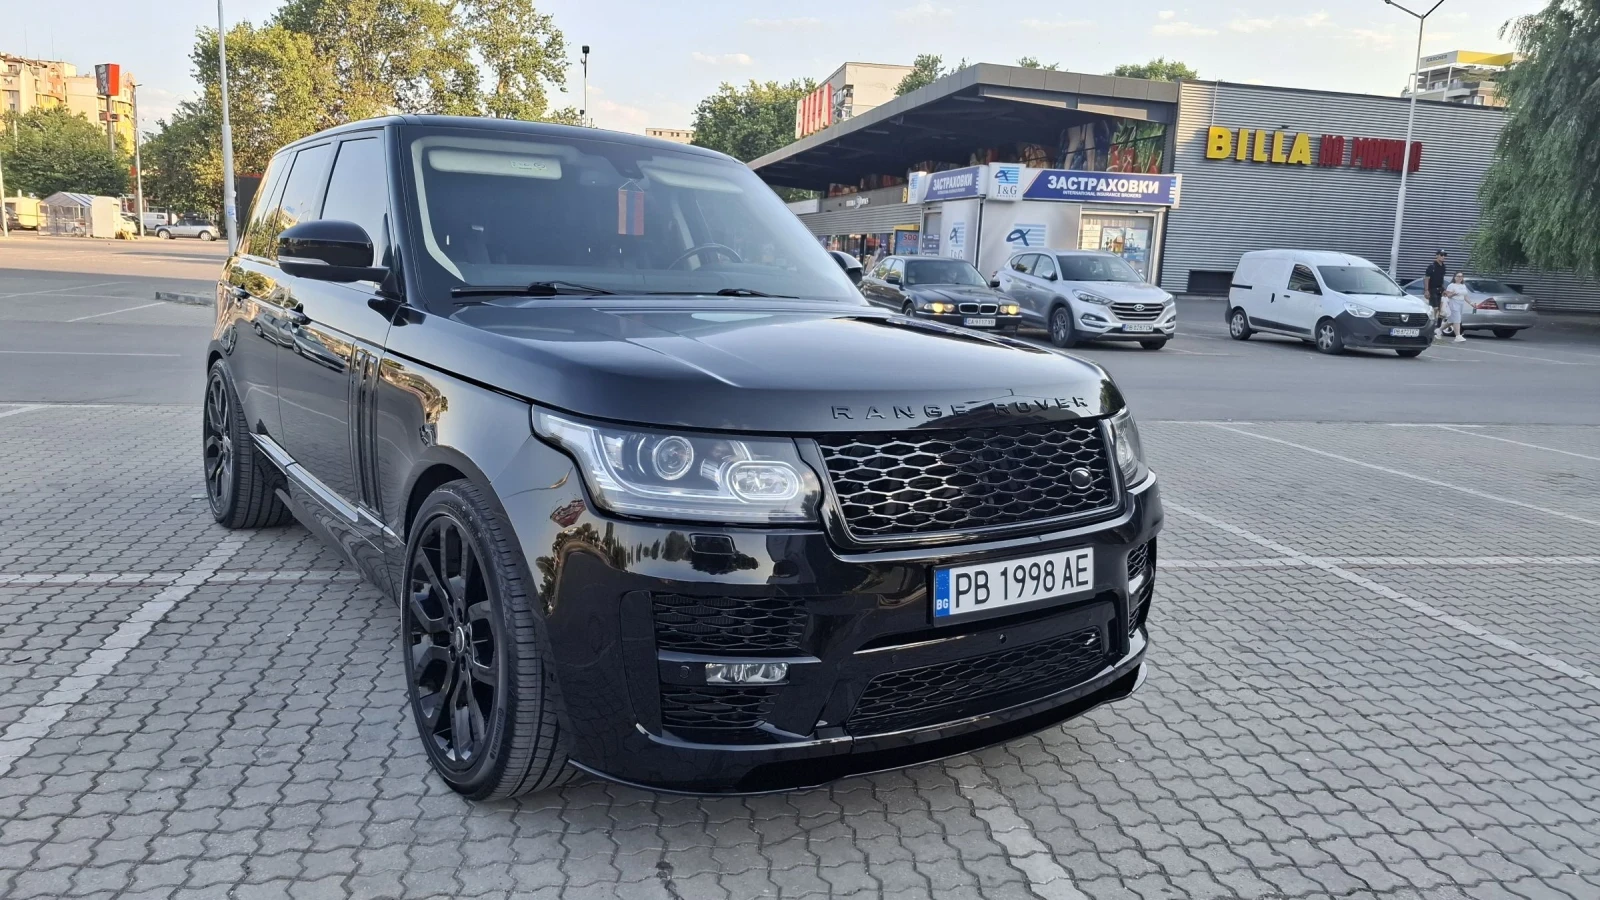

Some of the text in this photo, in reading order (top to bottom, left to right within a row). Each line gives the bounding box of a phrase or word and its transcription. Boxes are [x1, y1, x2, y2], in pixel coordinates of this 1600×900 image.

[1206, 126, 1312, 165] BILLA
[933, 173, 973, 191] ЗАСТРАХОВКИ
[1047, 175, 1160, 194] ЗАСТРАХОВКИ
[830, 396, 1088, 420] RANGE ROVER
[955, 553, 1089, 609] PB 1998 AE
[935, 598, 949, 610] BG
